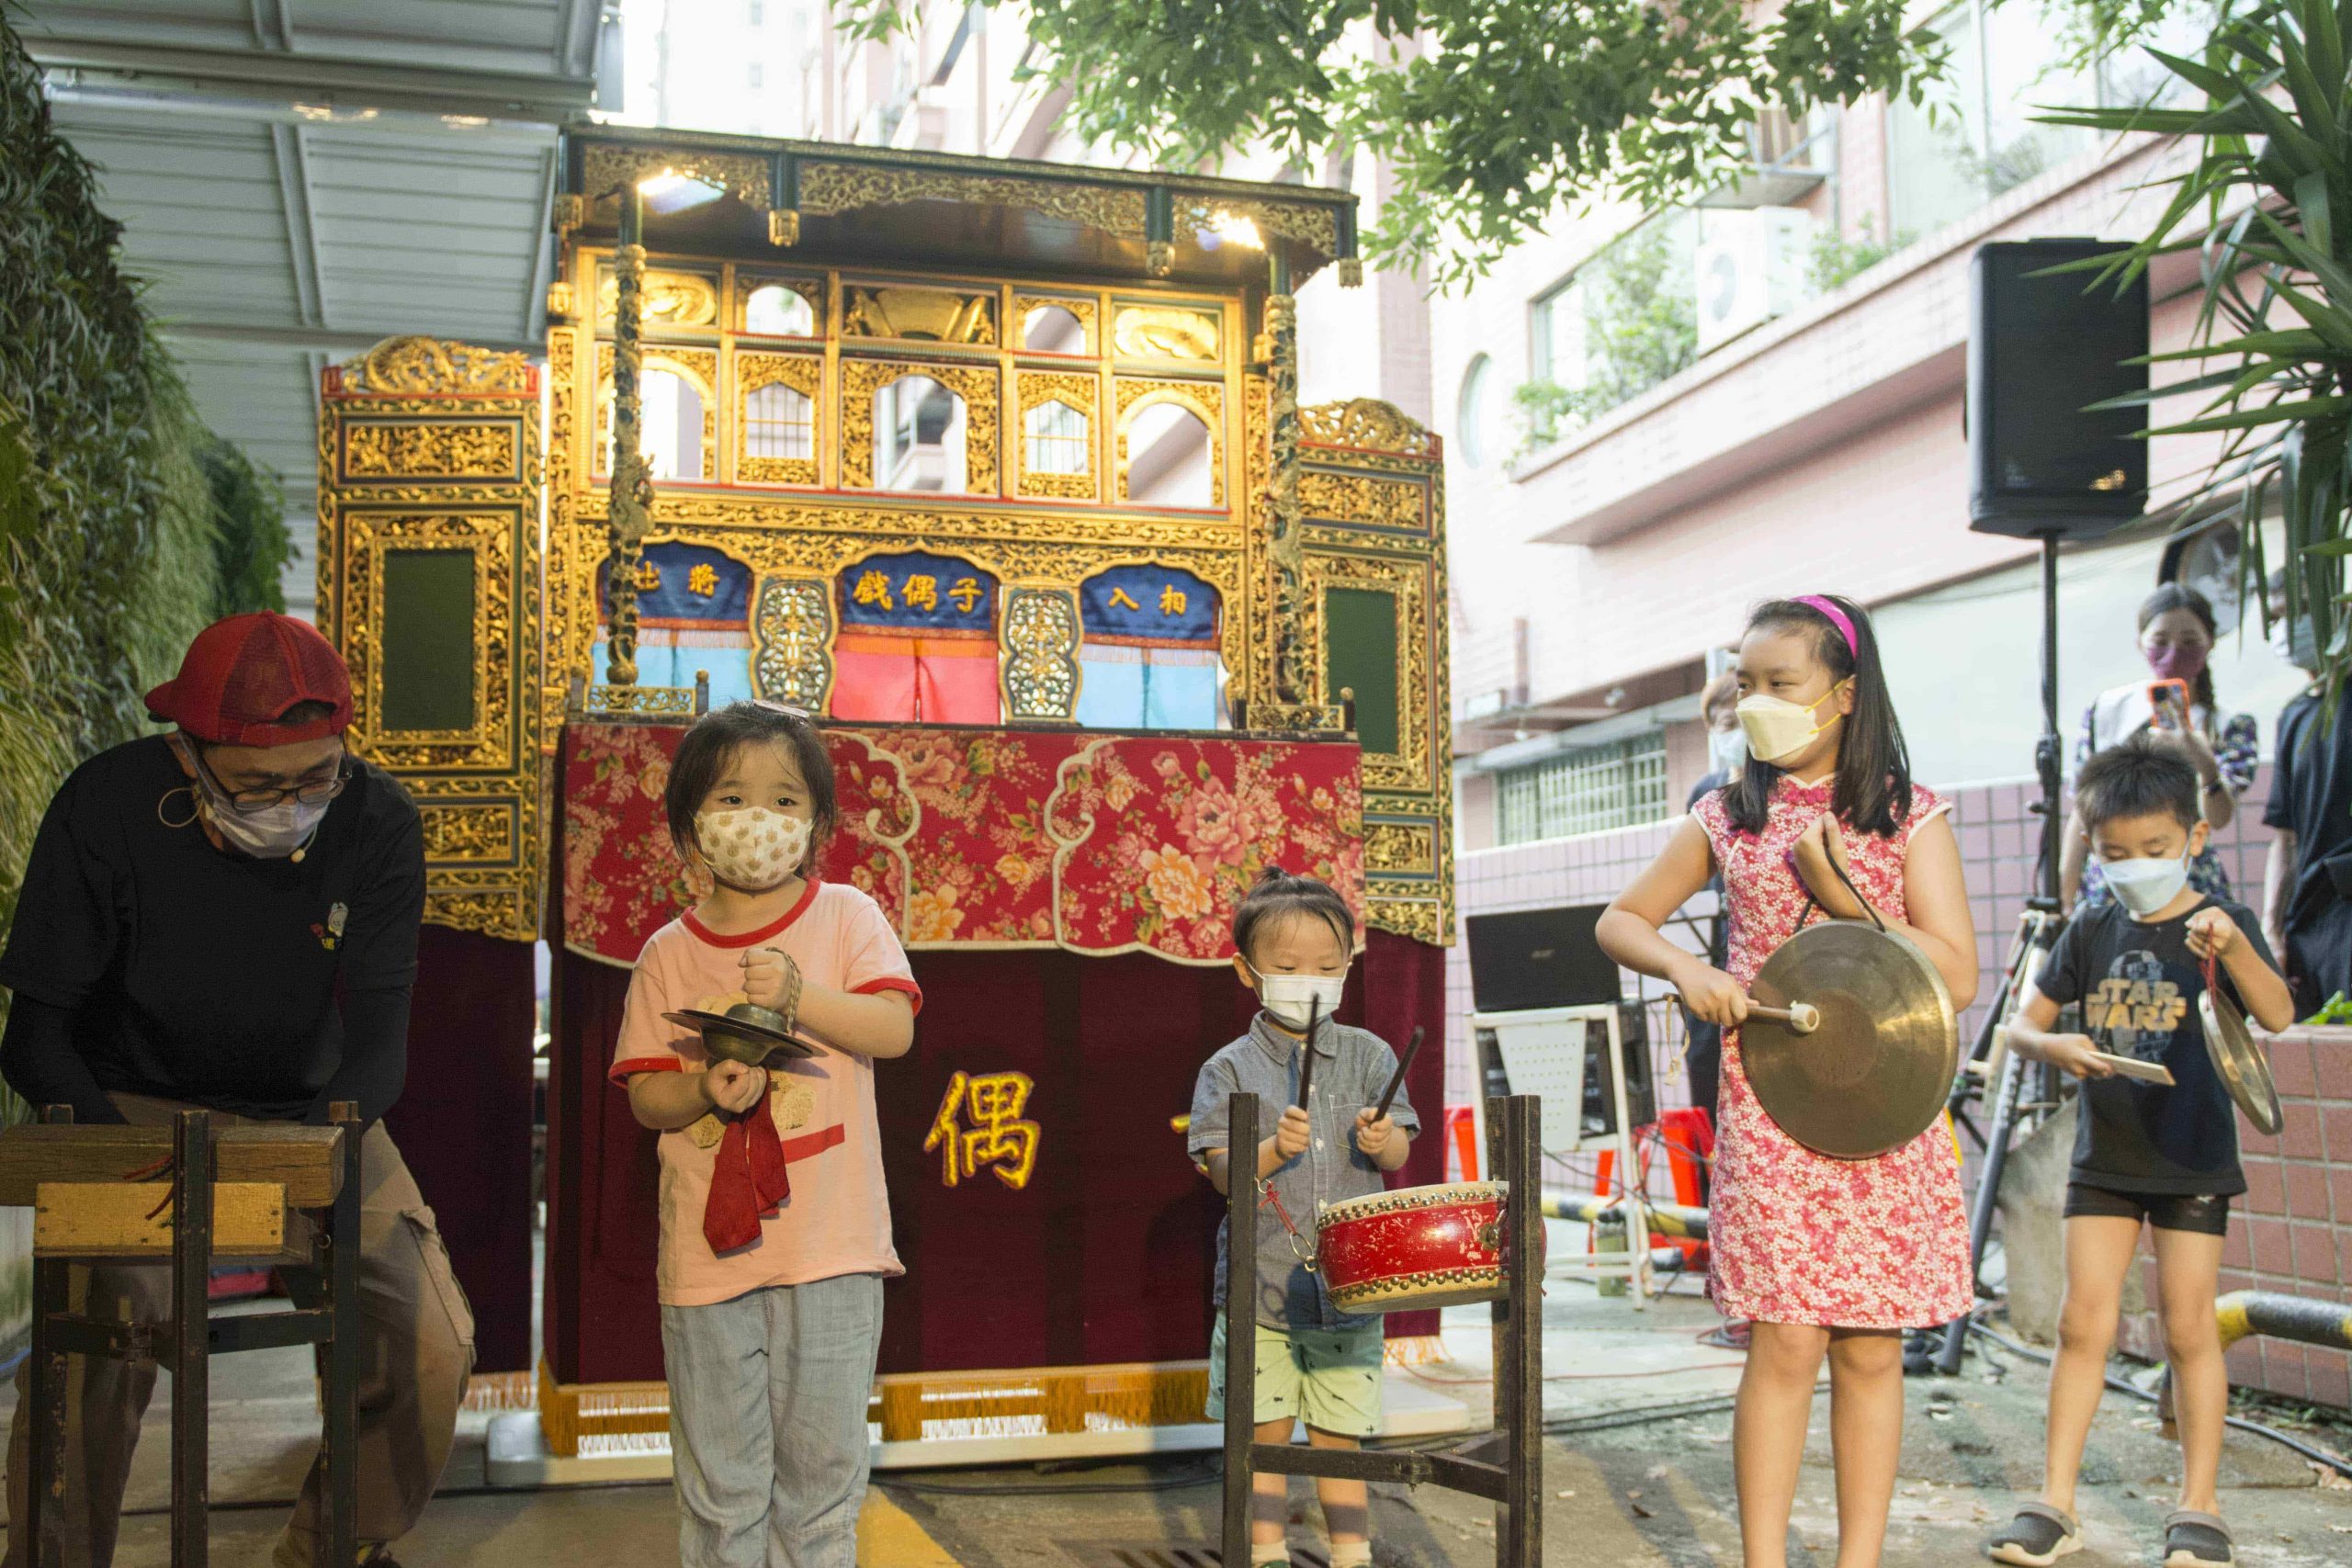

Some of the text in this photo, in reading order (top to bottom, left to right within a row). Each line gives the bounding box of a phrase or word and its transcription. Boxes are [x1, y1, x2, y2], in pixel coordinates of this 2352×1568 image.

[1108, 584, 1187, 616] 入相
[2086, 978, 2186, 1006] STAR
[2086, 998, 2187, 1031] WARS
[924, 1071, 1041, 1190] 偶
